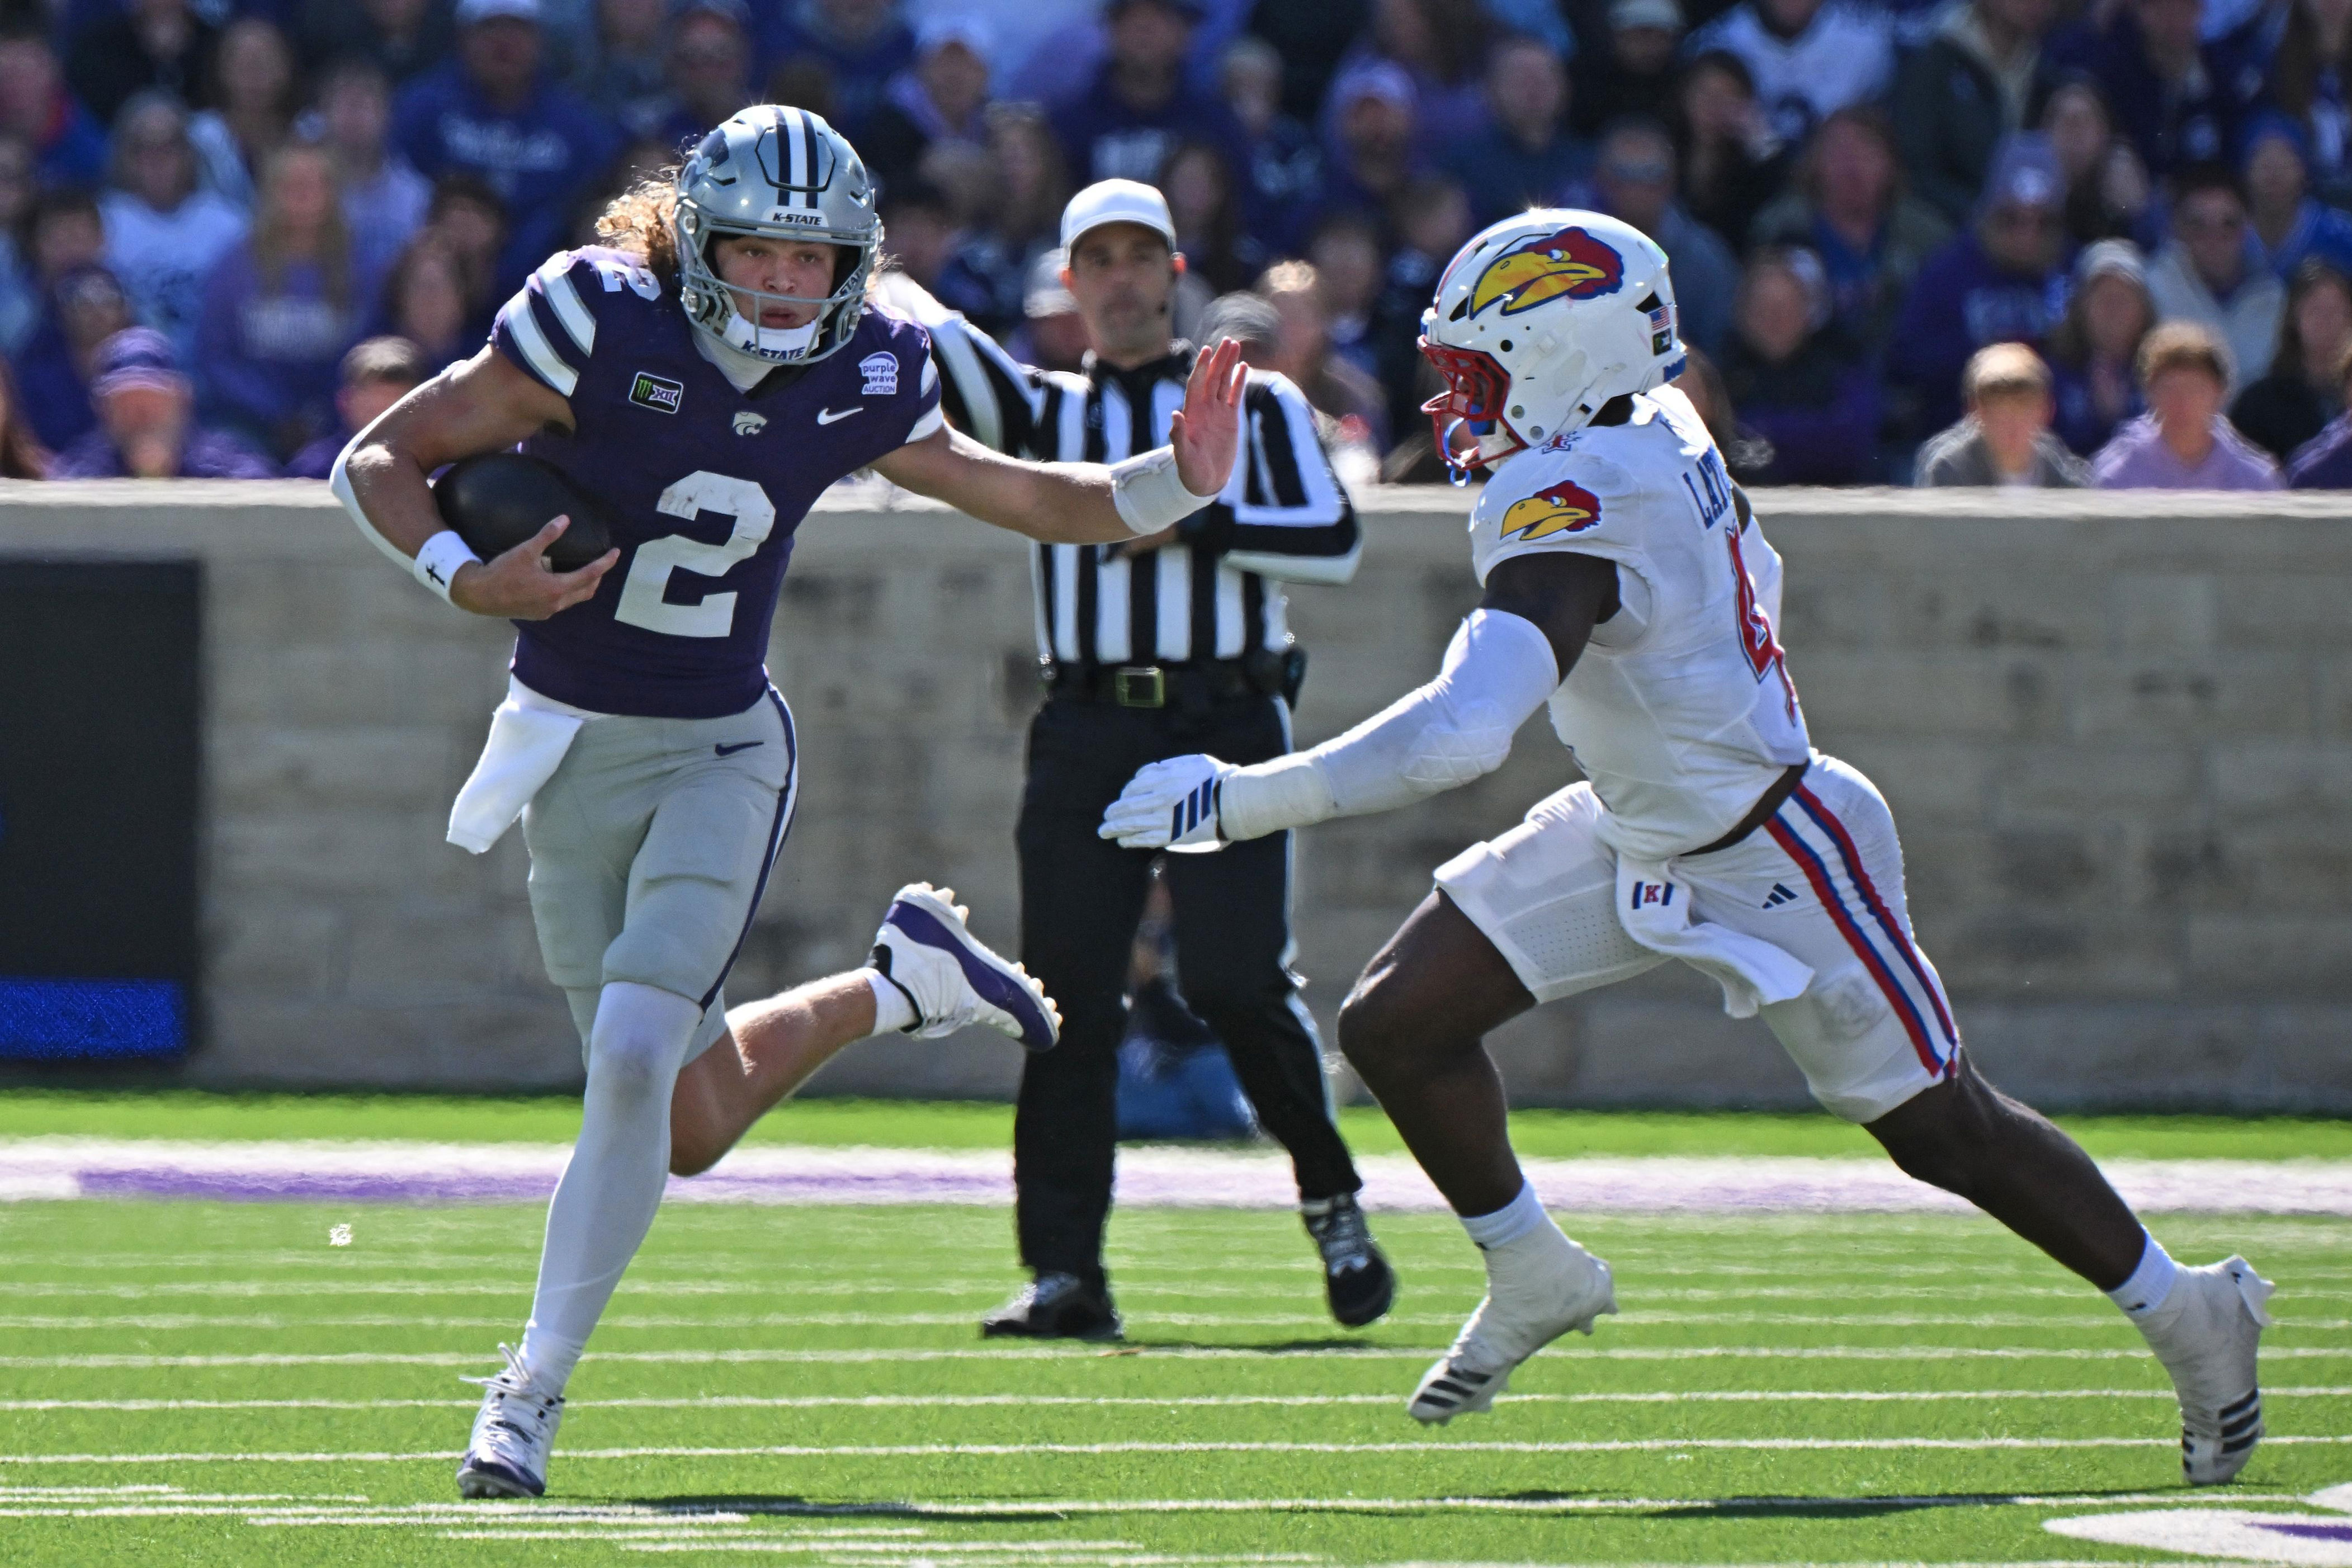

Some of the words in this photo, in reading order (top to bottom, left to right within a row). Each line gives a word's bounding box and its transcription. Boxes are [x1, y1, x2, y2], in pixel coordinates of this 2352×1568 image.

[772, 212, 822, 225] K-STATE
[863, 362, 896, 374] purple
[614, 470, 776, 637] 2
[1644, 885, 1661, 904] K
